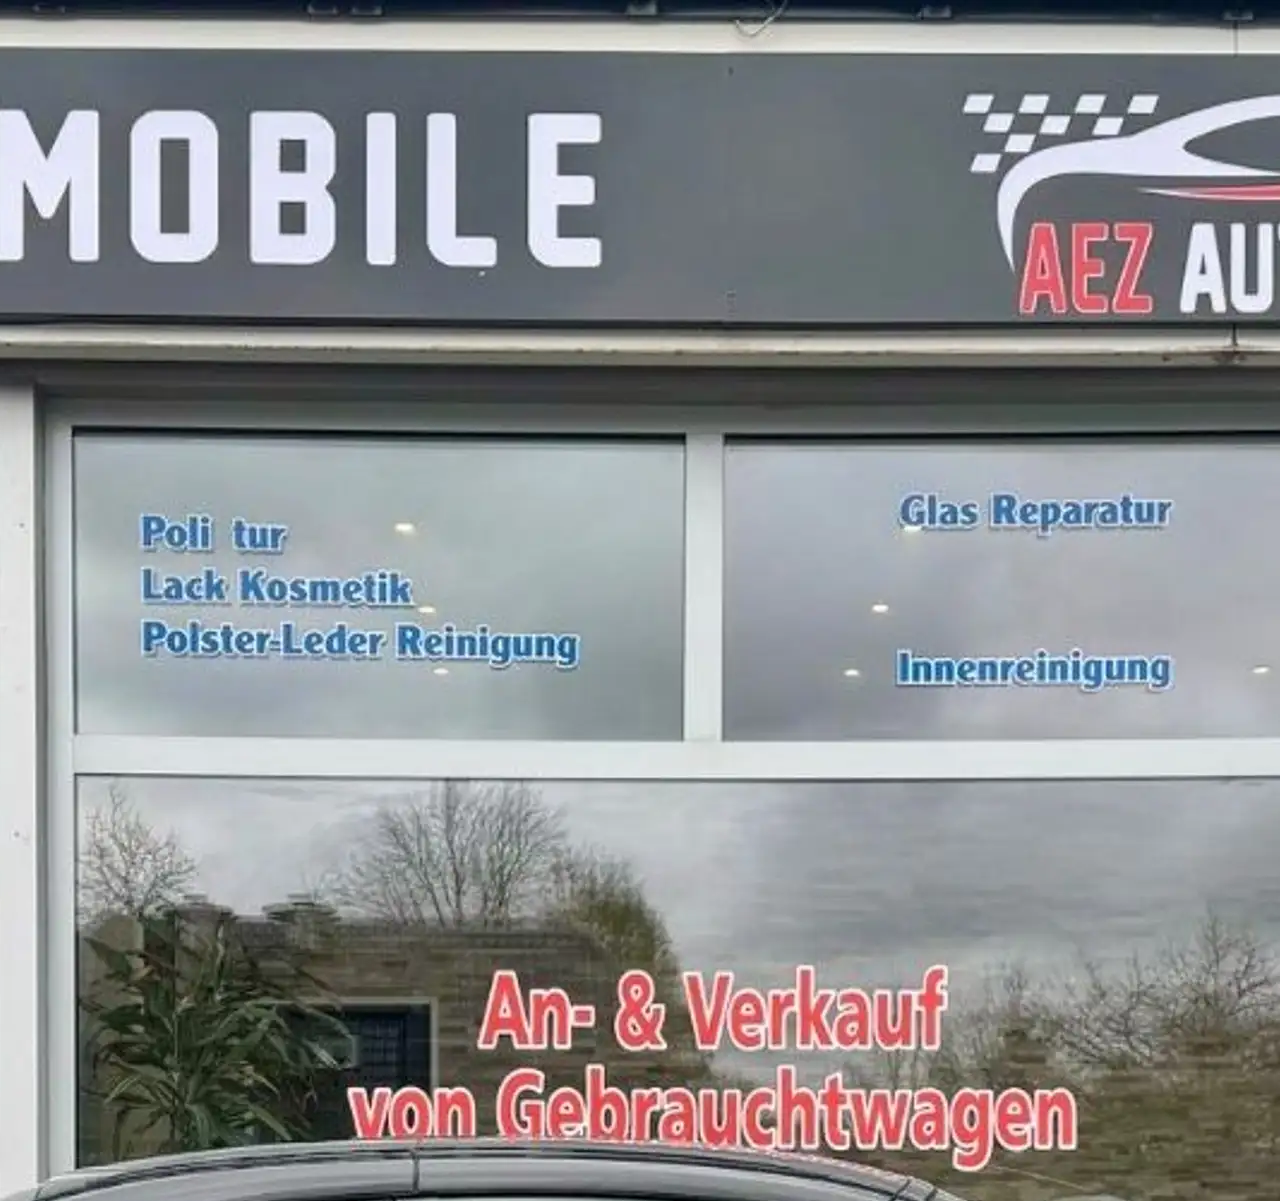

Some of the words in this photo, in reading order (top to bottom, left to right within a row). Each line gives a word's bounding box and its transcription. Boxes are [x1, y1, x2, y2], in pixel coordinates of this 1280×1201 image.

[1019, 222, 1154, 314] AEZ
[141, 514, 212, 551] Poli
[232, 517, 287, 553] tur
[898, 491, 979, 530] Glas
[990, 490, 1173, 536] Reparatur
[141, 567, 227, 604] Lack
[238, 569, 414, 606] Kosmetik
[140, 619, 387, 658] Polster-Leder
[395, 623, 580, 667] Reinigung
[896, 649, 1173, 691] Innenreinigung
[478, 970, 595, 1050] An-
[614, 969, 667, 1050] &
[684, 965, 948, 1052] Verkauf
[347, 1085, 476, 1141] von
[496, 1063, 1078, 1170] Gebrauchtwagen
